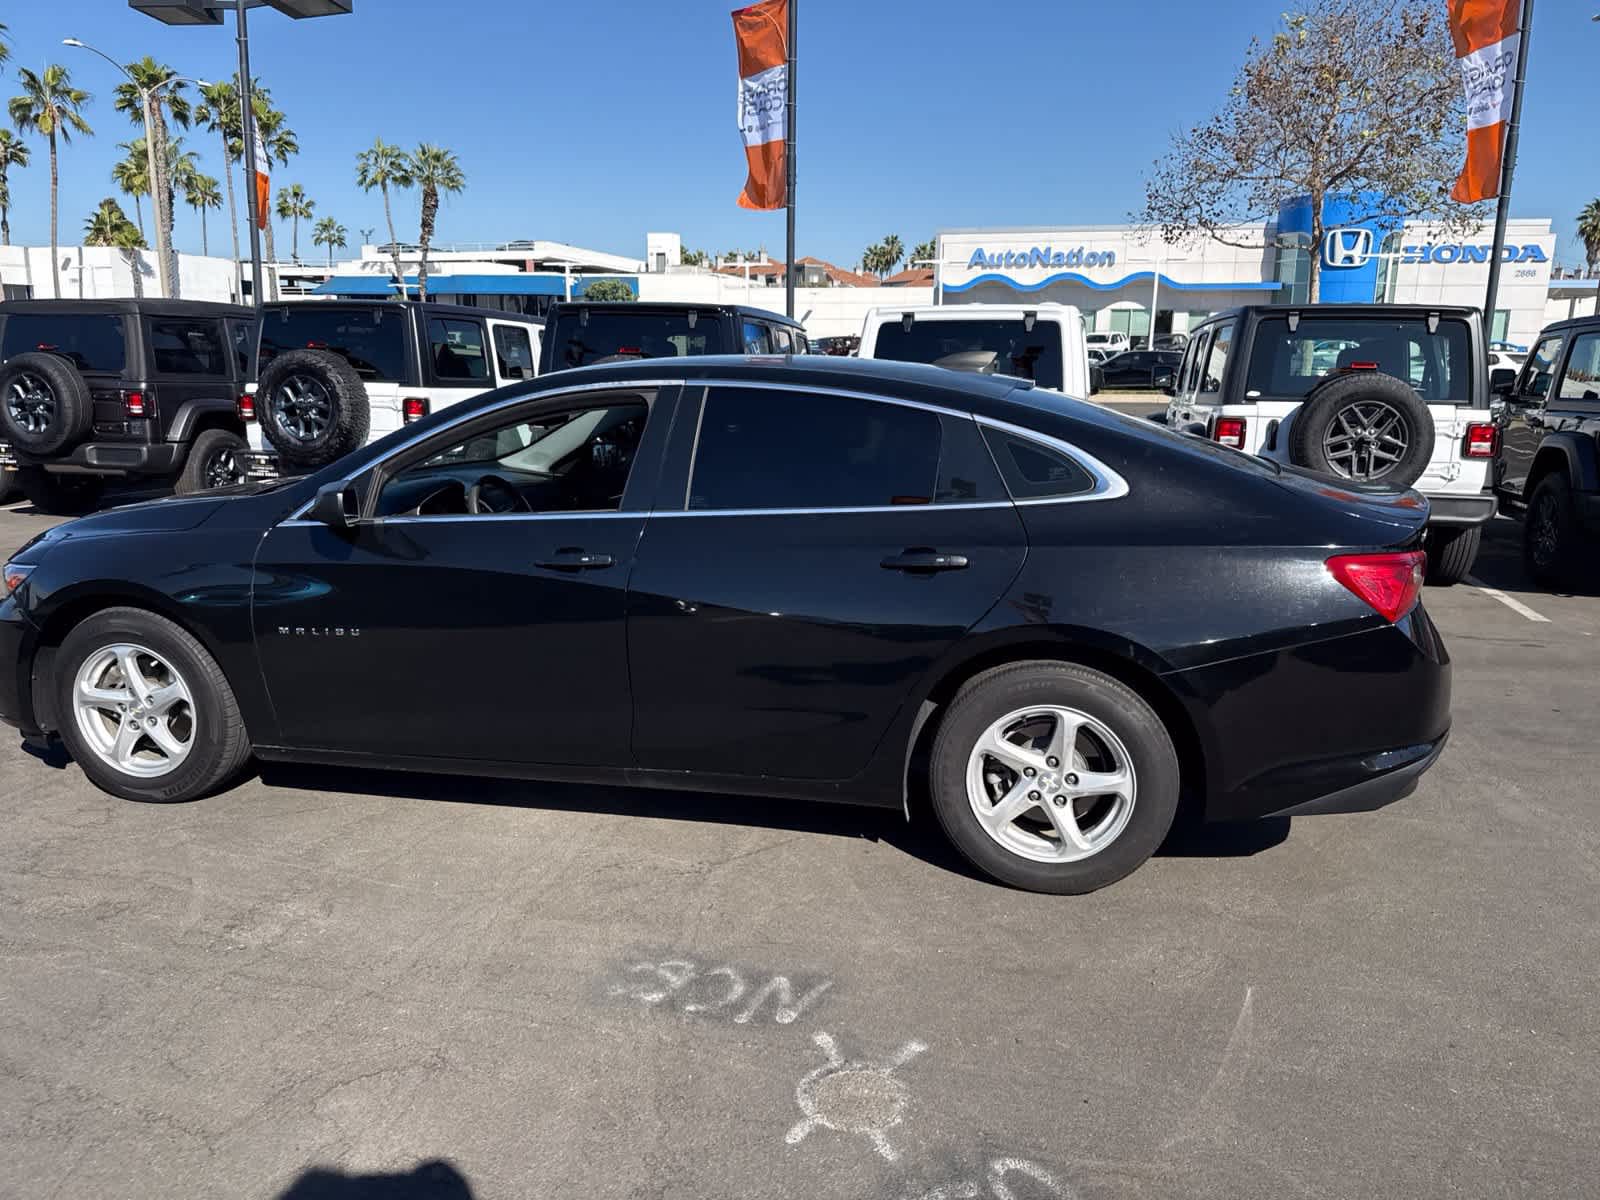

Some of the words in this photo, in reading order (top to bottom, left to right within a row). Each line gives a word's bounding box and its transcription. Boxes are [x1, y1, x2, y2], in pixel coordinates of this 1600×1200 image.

[967, 246, 1116, 269] AutoNation
[1400, 243, 1549, 264] HONDA
[278, 626, 361, 636] MALIBU
